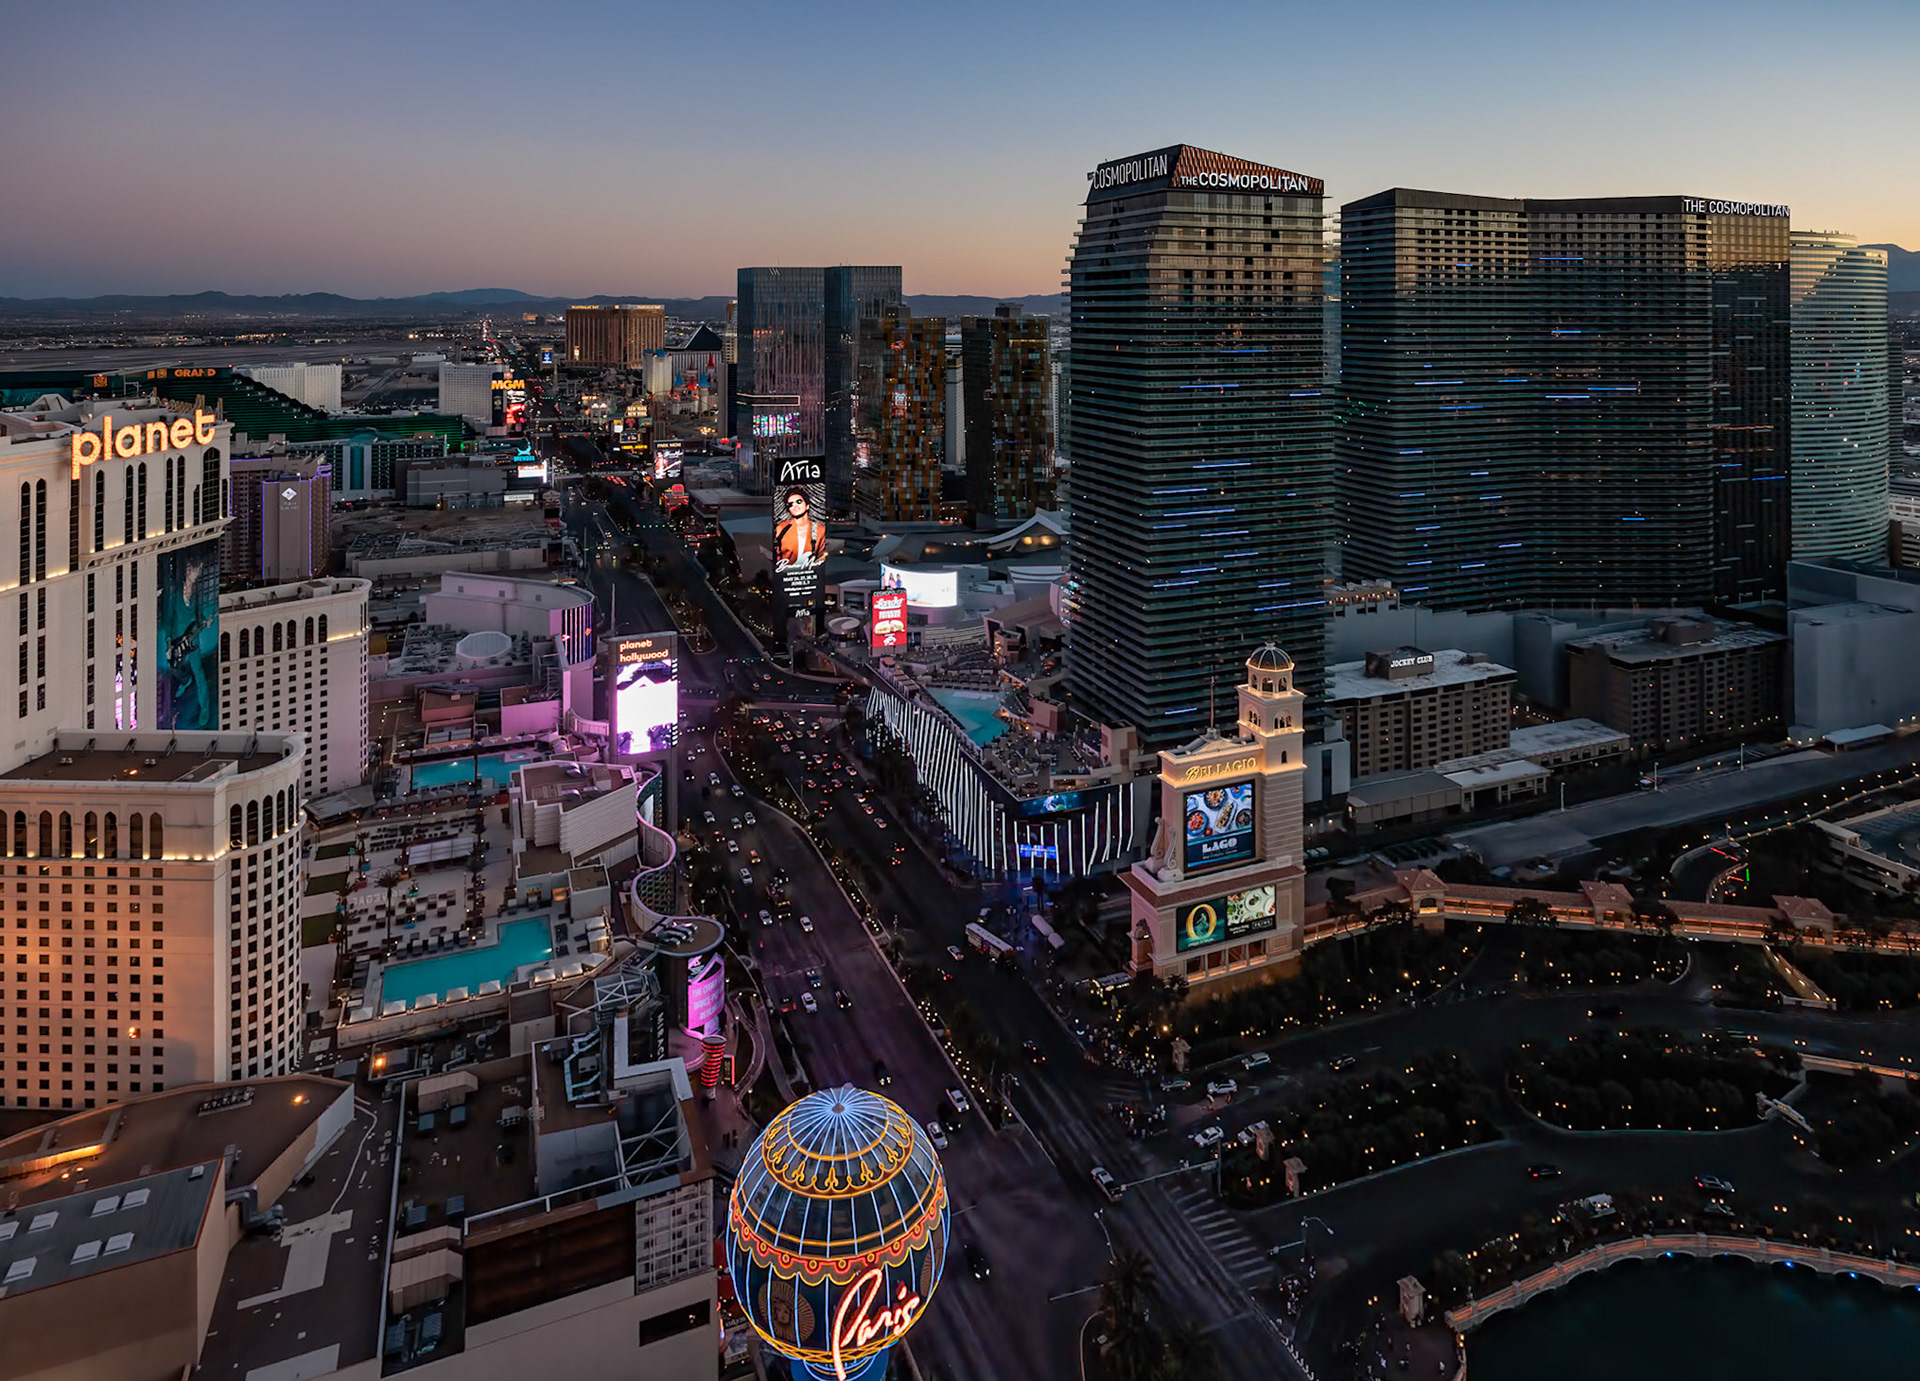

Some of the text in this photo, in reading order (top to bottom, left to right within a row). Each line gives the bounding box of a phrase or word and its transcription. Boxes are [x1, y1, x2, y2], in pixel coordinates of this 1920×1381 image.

[1093, 154, 1168, 189] COSMOPOLITAN
[1180, 172, 1308, 192] THE COSMOPOLITAN
[1684, 199, 1790, 217] THE COSMOPOLITAN
[174, 368, 216, 378] GRAND
[491, 379, 525, 390] MGM
[71, 409, 216, 480] planet
[780, 460, 821, 482] Aria
[620, 639, 653, 653] planet
[620, 648, 669, 663] hollywood
[1391, 655, 1433, 668] JOCKEY CLUB
[1181, 757, 1257, 780] BELLAGIO
[1202, 837, 1238, 853] LAGO
[832, 1268, 920, 1381] Paris
